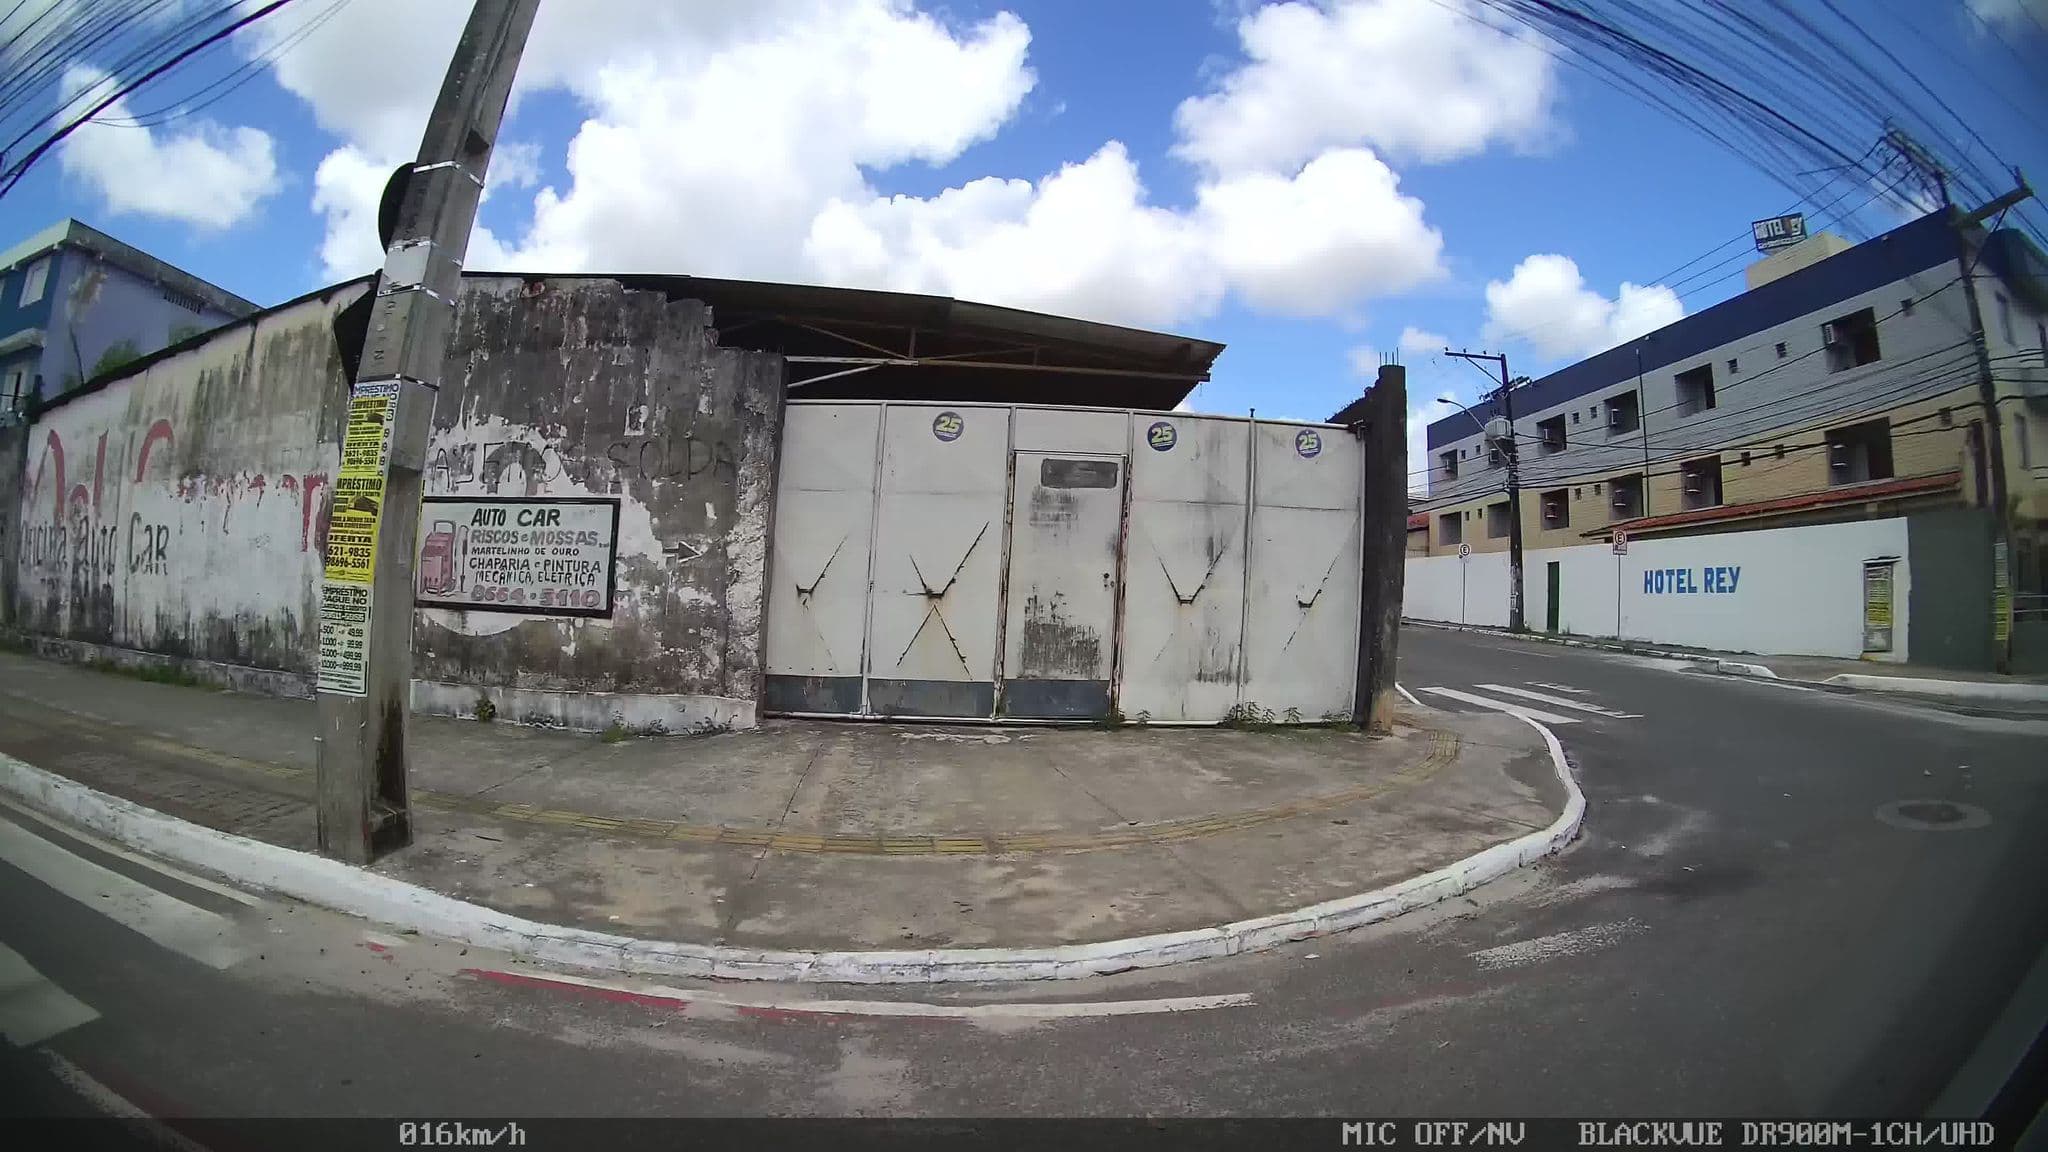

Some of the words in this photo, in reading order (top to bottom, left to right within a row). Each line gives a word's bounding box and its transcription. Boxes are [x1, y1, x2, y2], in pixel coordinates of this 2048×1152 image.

[936, 416, 961, 434] 25
[1152, 426, 1174, 444] 25
[1299, 433, 1318, 450] 25
[471, 508, 507, 527] AUTO
[517, 508, 561, 527] CAR
[470, 529, 519, 545] RISCOS
[530, 530, 598, 546] MOSSAS
[471, 547, 530, 556] MARTELINHO
[534, 548, 546, 556] DE
[552, 548, 580, 557] OURO
[469, 557, 531, 571] CHAPARIA
[543, 559, 602, 573] PINTURA
[1644, 569, 1697, 594] HOTEL
[1704, 566, 1741, 594] REY
